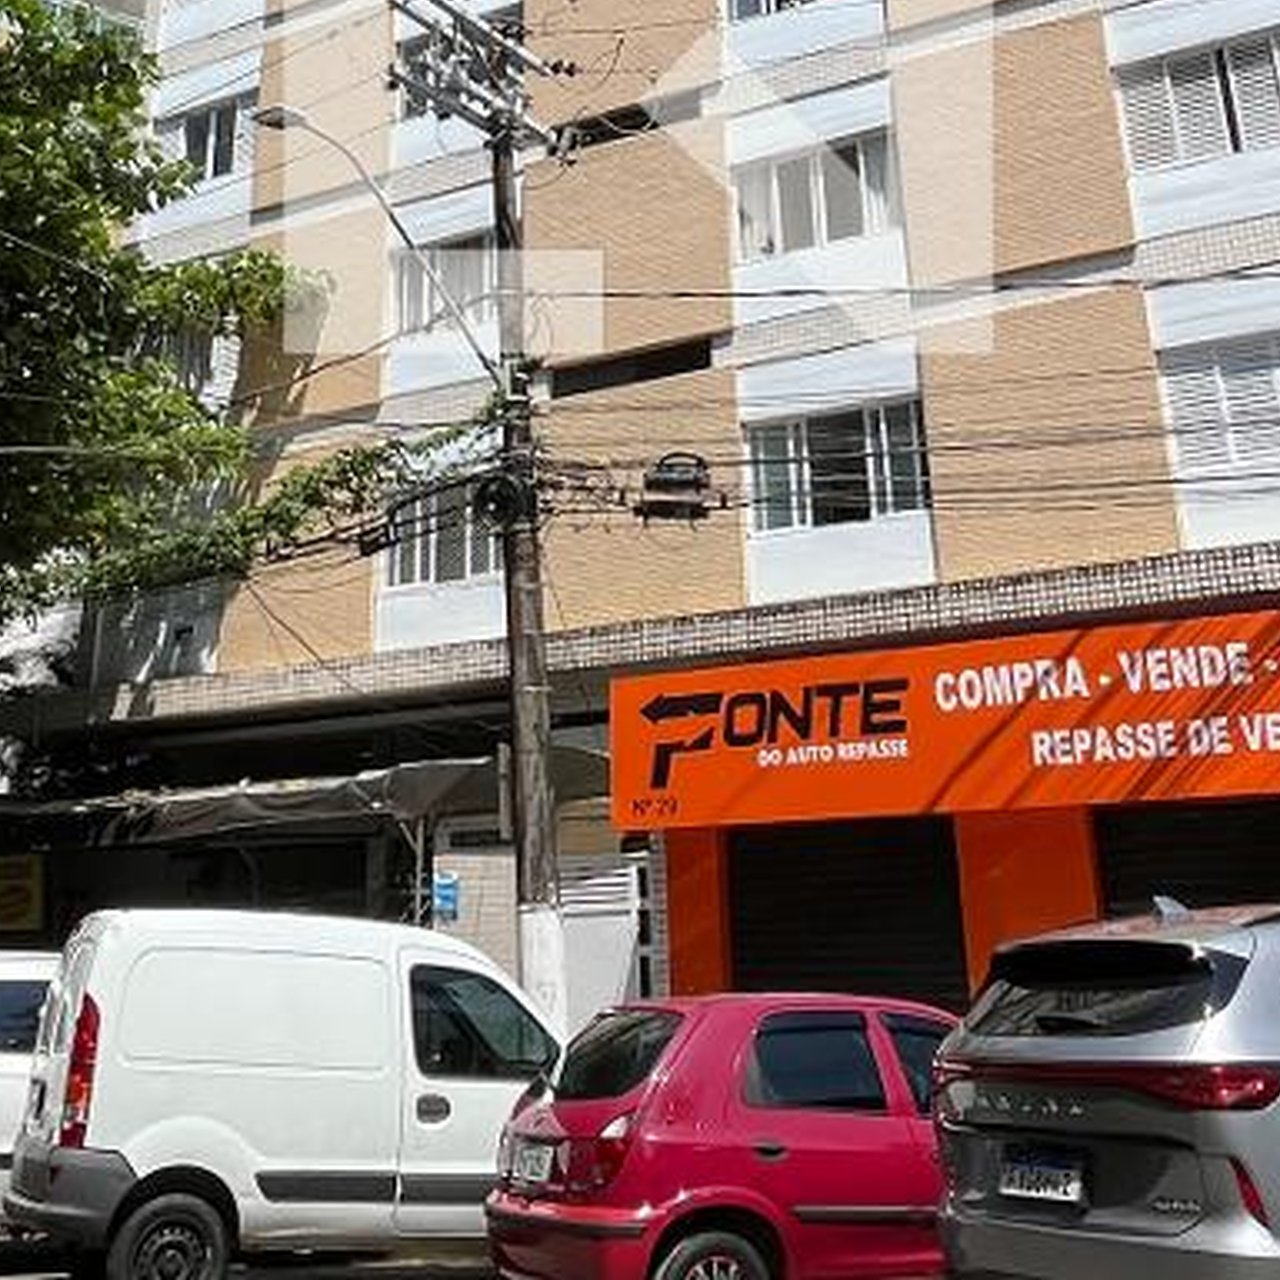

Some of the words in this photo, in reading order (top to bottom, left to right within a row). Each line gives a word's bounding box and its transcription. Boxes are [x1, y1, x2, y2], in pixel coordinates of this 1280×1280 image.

[934, 657, 1090, 711] COMPRA
[1117, 642, 1254, 695] VENDE
[639, 677, 910, 790] FONTE
[757, 749, 781, 767] DO
[786, 743, 835, 765] AUTO
[838, 738, 909, 760] REPASSE
[1031, 720, 1178, 767] REPASSE
[1187, 716, 1234, 756] DE
